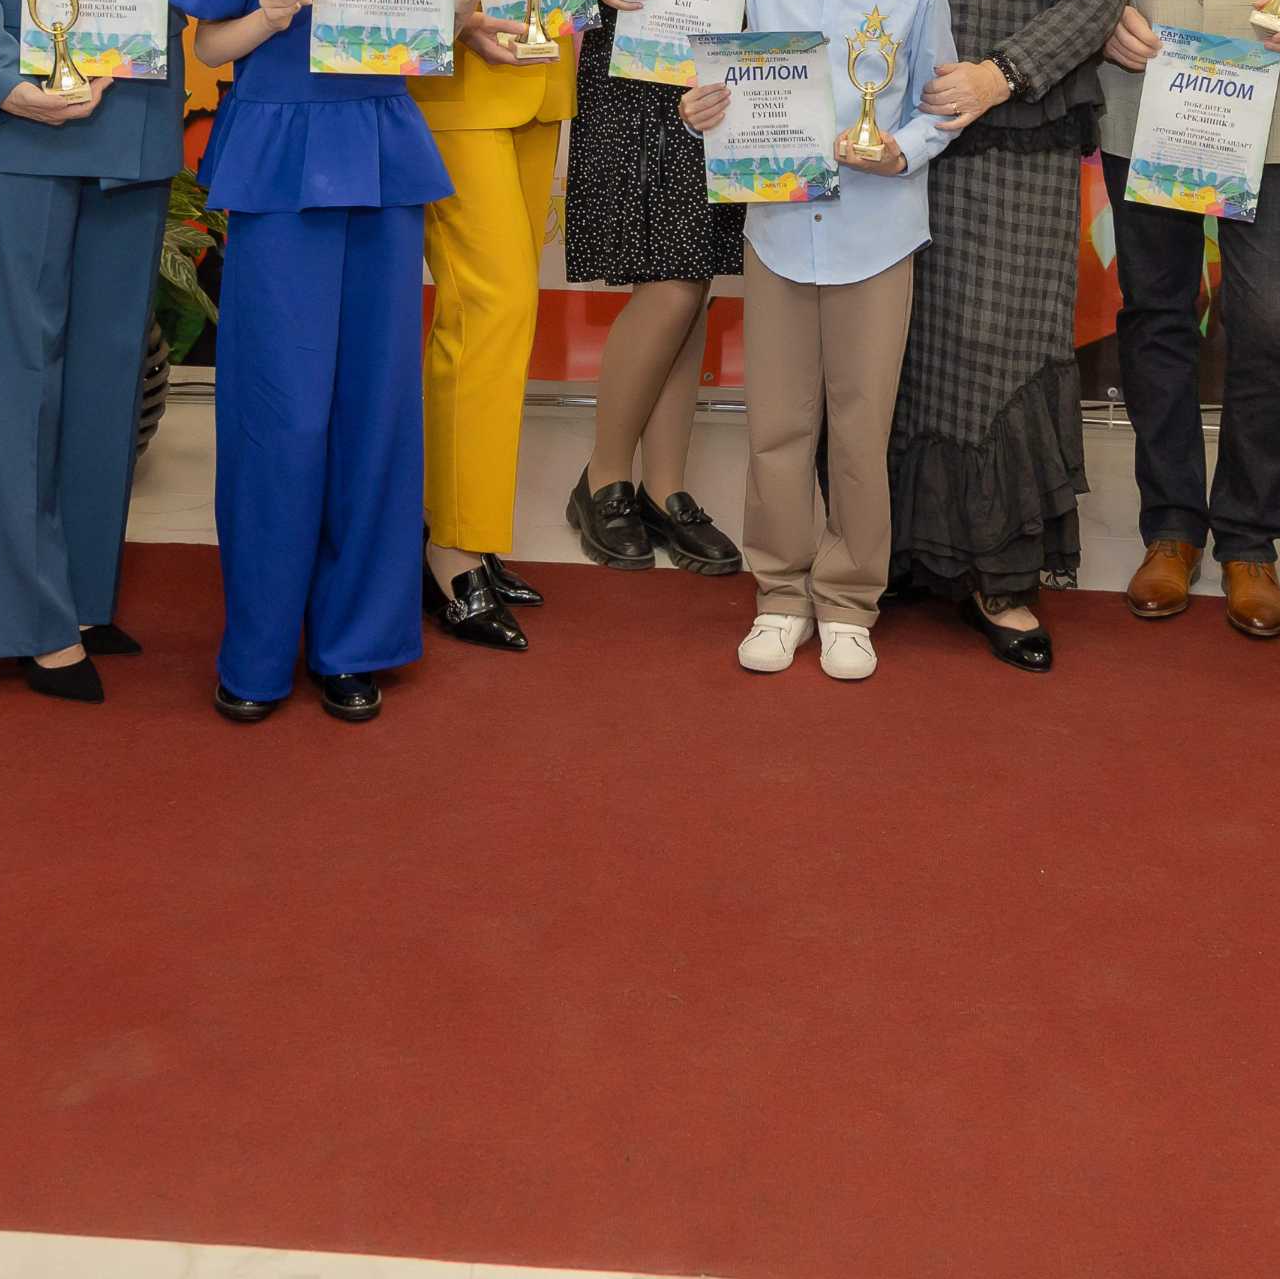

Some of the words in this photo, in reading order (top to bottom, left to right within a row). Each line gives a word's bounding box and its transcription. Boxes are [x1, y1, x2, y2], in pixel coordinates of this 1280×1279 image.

[1161, 31, 1201, 42] САРАТОВ
[724, 65, 808, 86] ДИПЛОМ
[1170, 73, 1254, 100] ДИПЛОМ
